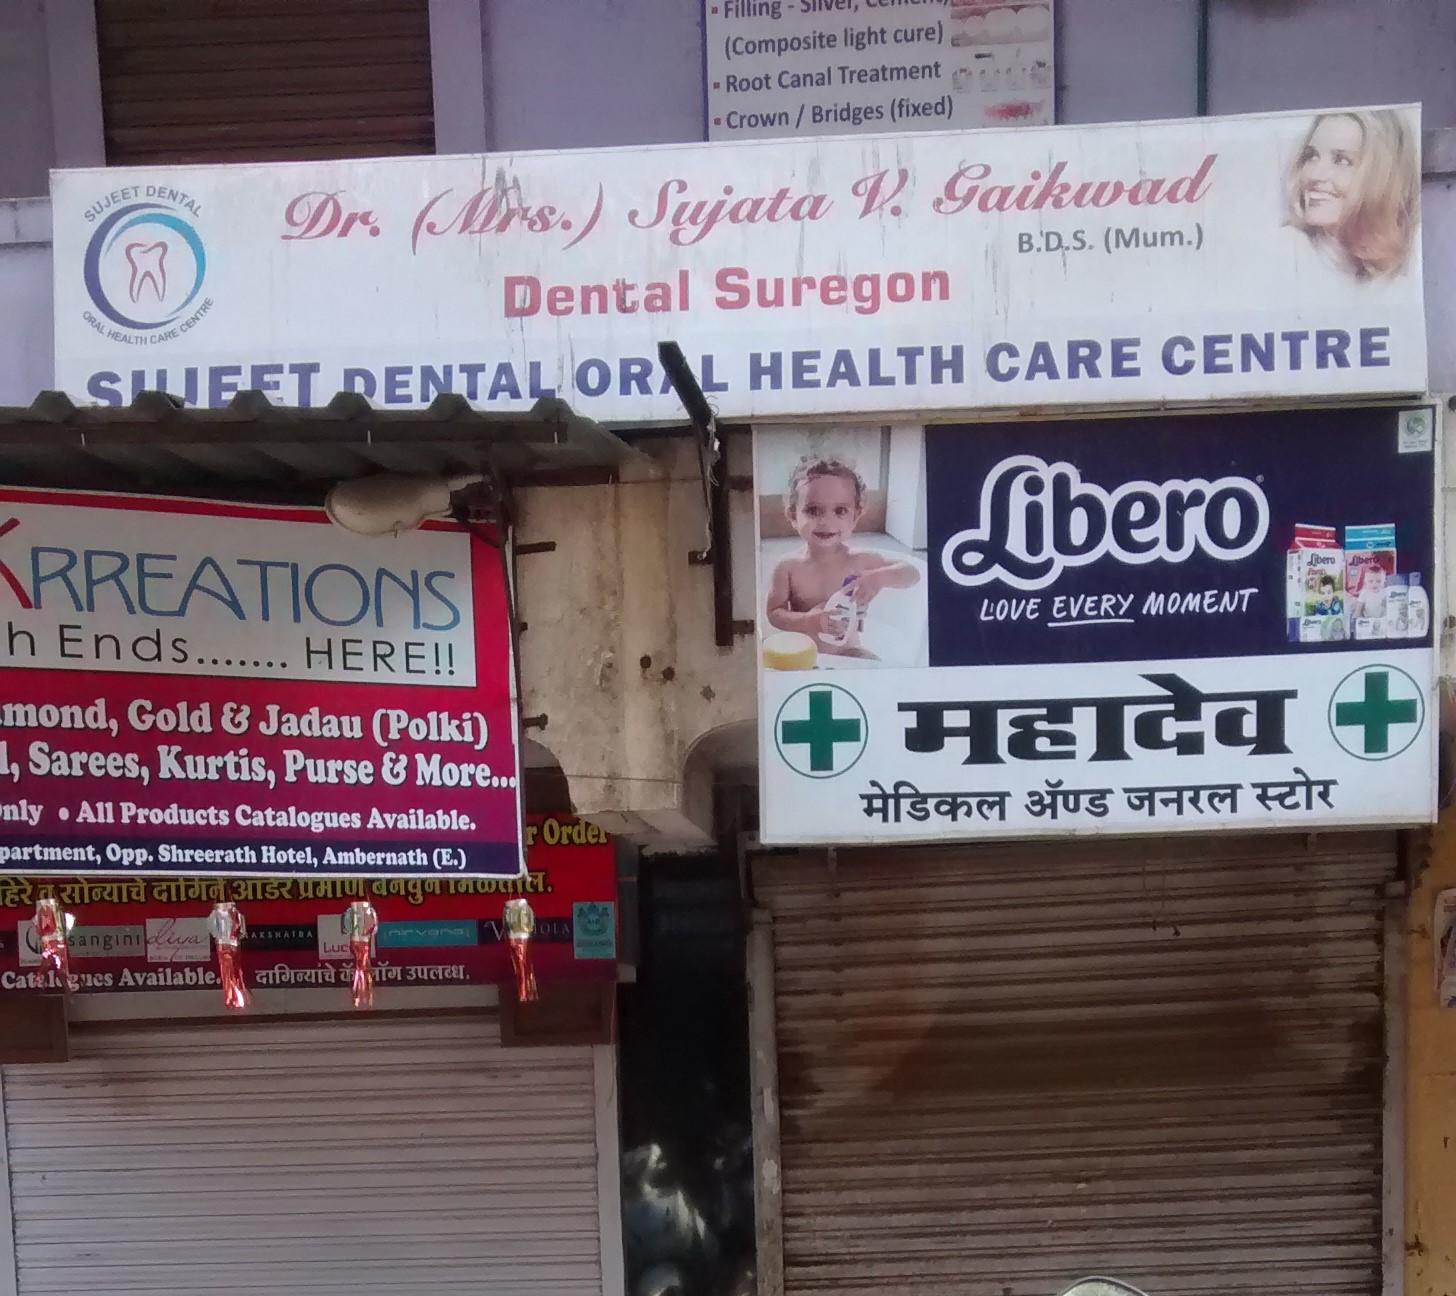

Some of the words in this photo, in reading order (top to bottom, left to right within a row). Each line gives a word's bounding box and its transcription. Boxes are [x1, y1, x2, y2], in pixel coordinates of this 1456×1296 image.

[723, 0, 782, 19] Filling
[725, 30, 838, 60] (Composite
[844, 25, 887, 50] light
[893, 20, 944, 45] cure)
[725, 73, 772, 93] Root
[777, 67, 831, 90] Canal
[838, 61, 941, 86] Treatment
[726, 108, 789, 129] Crown
[811, 100, 884, 126] Bridges
[890, 95, 954, 123] (fixed)
[84, 185, 140, 223] SUJEET
[146, 185, 202, 218] DENTAL
[280, 188, 381, 241] Dr.
[411, 181, 603, 256] (Mrs.)
[627, 177, 835, 248] Sujata
[851, 167, 902, 218] V.
[932, 153, 1219, 217] Gaikwad
[1103, 223, 1205, 255] (Mum.)
[503, 268, 690, 318] Dental
[715, 267, 951, 314] Suregon
[82, 310, 105, 335] ORAL
[107, 329, 147, 345] HEALTH
[149, 328, 179, 345] CARE
[180, 297, 214, 332] CENTRE
[343, 361, 556, 404] DENTAL
[575, 354, 729, 397] ORL
[749, 345, 965, 391] HEALTH
[986, 337, 1141, 383] CARE
[1160, 326, 1392, 376] CENTRE
[941, 454, 1269, 590] Libero
[980, 598, 1040, 622] LOVE
[1048, 593, 1135, 618] EVERY
[1142, 588, 1259, 616] MOMENT
[306, 636, 456, 676] HERE!!
[128, 699, 213, 734] Gold
[221, 701, 251, 735] &
[259, 704, 363, 740] Jadau
[372, 707, 489, 750] (Polki)
[898, 673, 1298, 766] महादेव
[28, 740, 149, 786] Sarees,
[157, 744, 276, 790] Kurtis,
[283, 749, 374, 785] Purse
[381, 752, 409, 786] &
[415, 753, 517, 789] More...
[0, 798, 43, 826] nly
[76, 800, 114, 824] All
[120, 801, 229, 827] Products
[235, 804, 361, 832] Catalogues
[367, 807, 476, 831] Available.
[860, 780, 1011, 823] मेडिकल
[1127, 781, 1243, 818] जनरल
[1252, 767, 1339, 811] स्टोर
[106, 843, 153, 867] Opp.
[158, 843, 257, 864] Shreerath
[261, 845, 318, 868] Hotel,
[323, 847, 428, 866] Ambernath
[432, 848, 467, 869] (E.)
[69, 934, 140, 950] sangini
[1, 969, 114, 993] Catlgues
[118, 966, 221, 987] Available.
